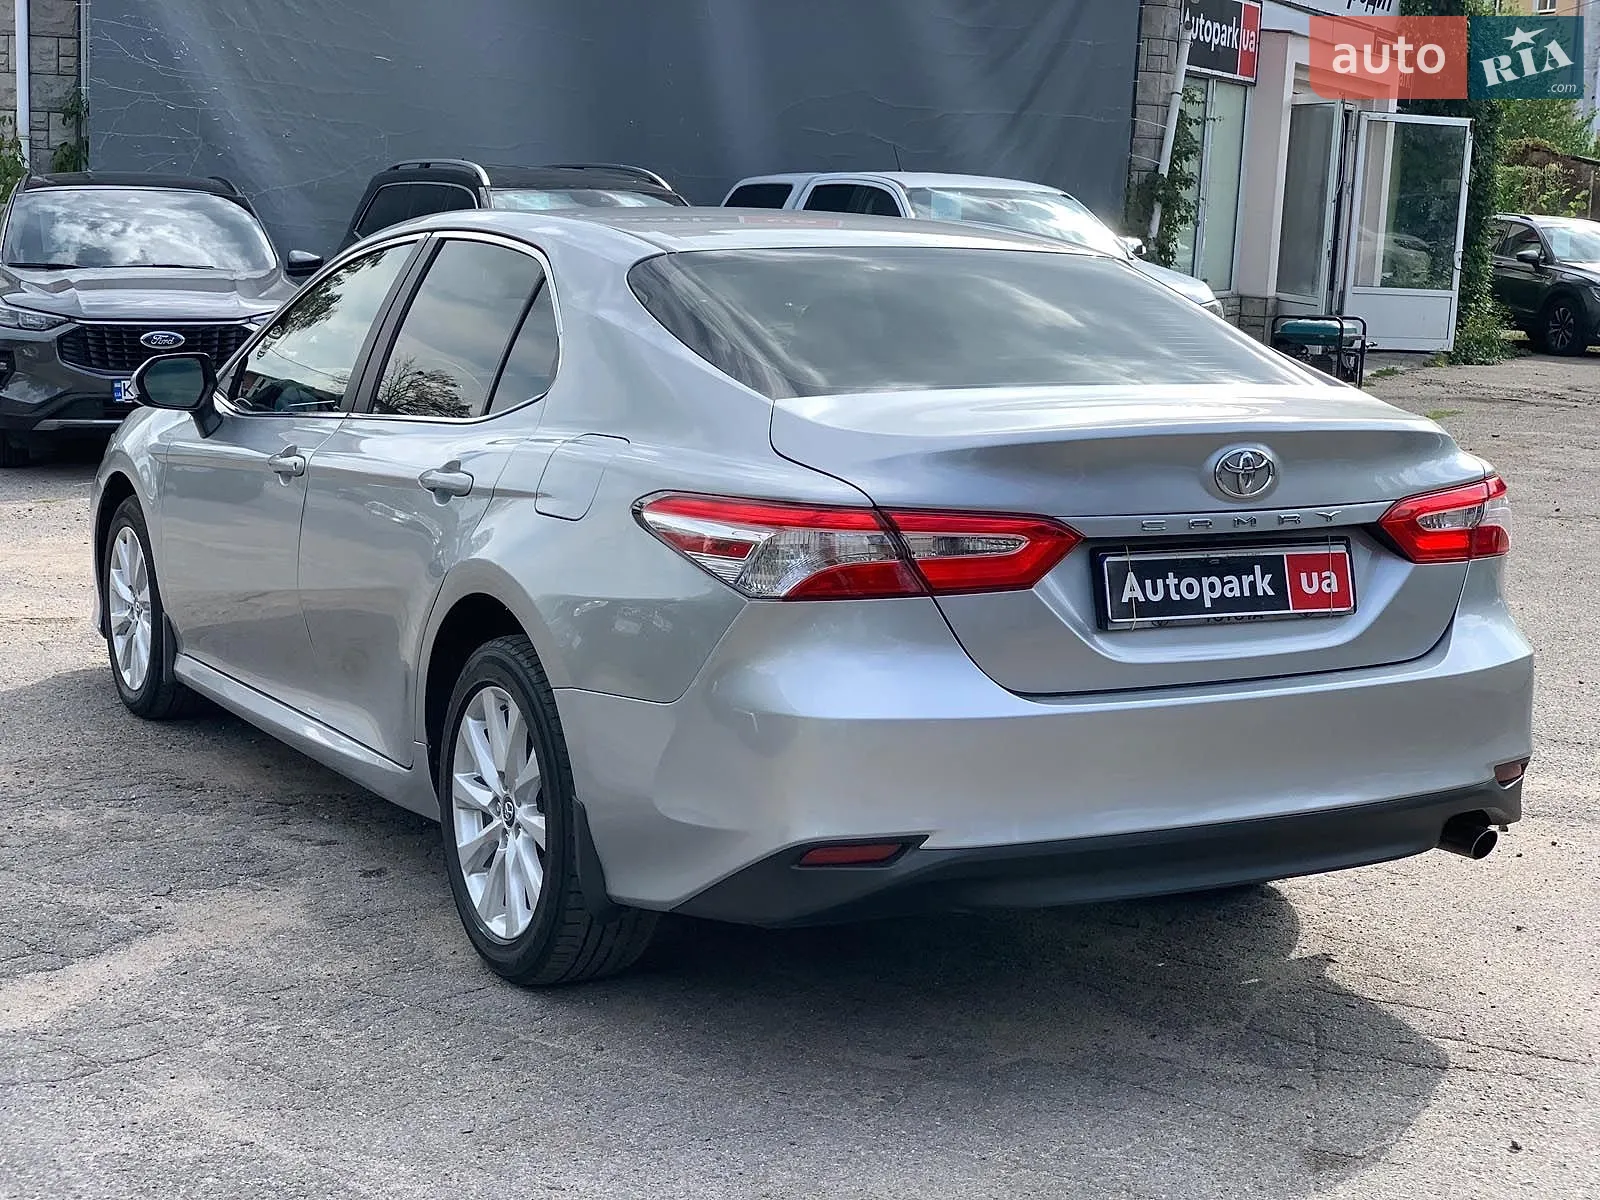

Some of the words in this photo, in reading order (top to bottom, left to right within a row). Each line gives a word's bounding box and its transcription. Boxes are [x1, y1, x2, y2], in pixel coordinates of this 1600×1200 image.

[1242, 28, 1256, 53] ua
[150, 334, 175, 345] Ford
[1141, 511, 1341, 531] CAMRY
[1121, 564, 1275, 608] Autopark
[1300, 570, 1338, 595] ua
